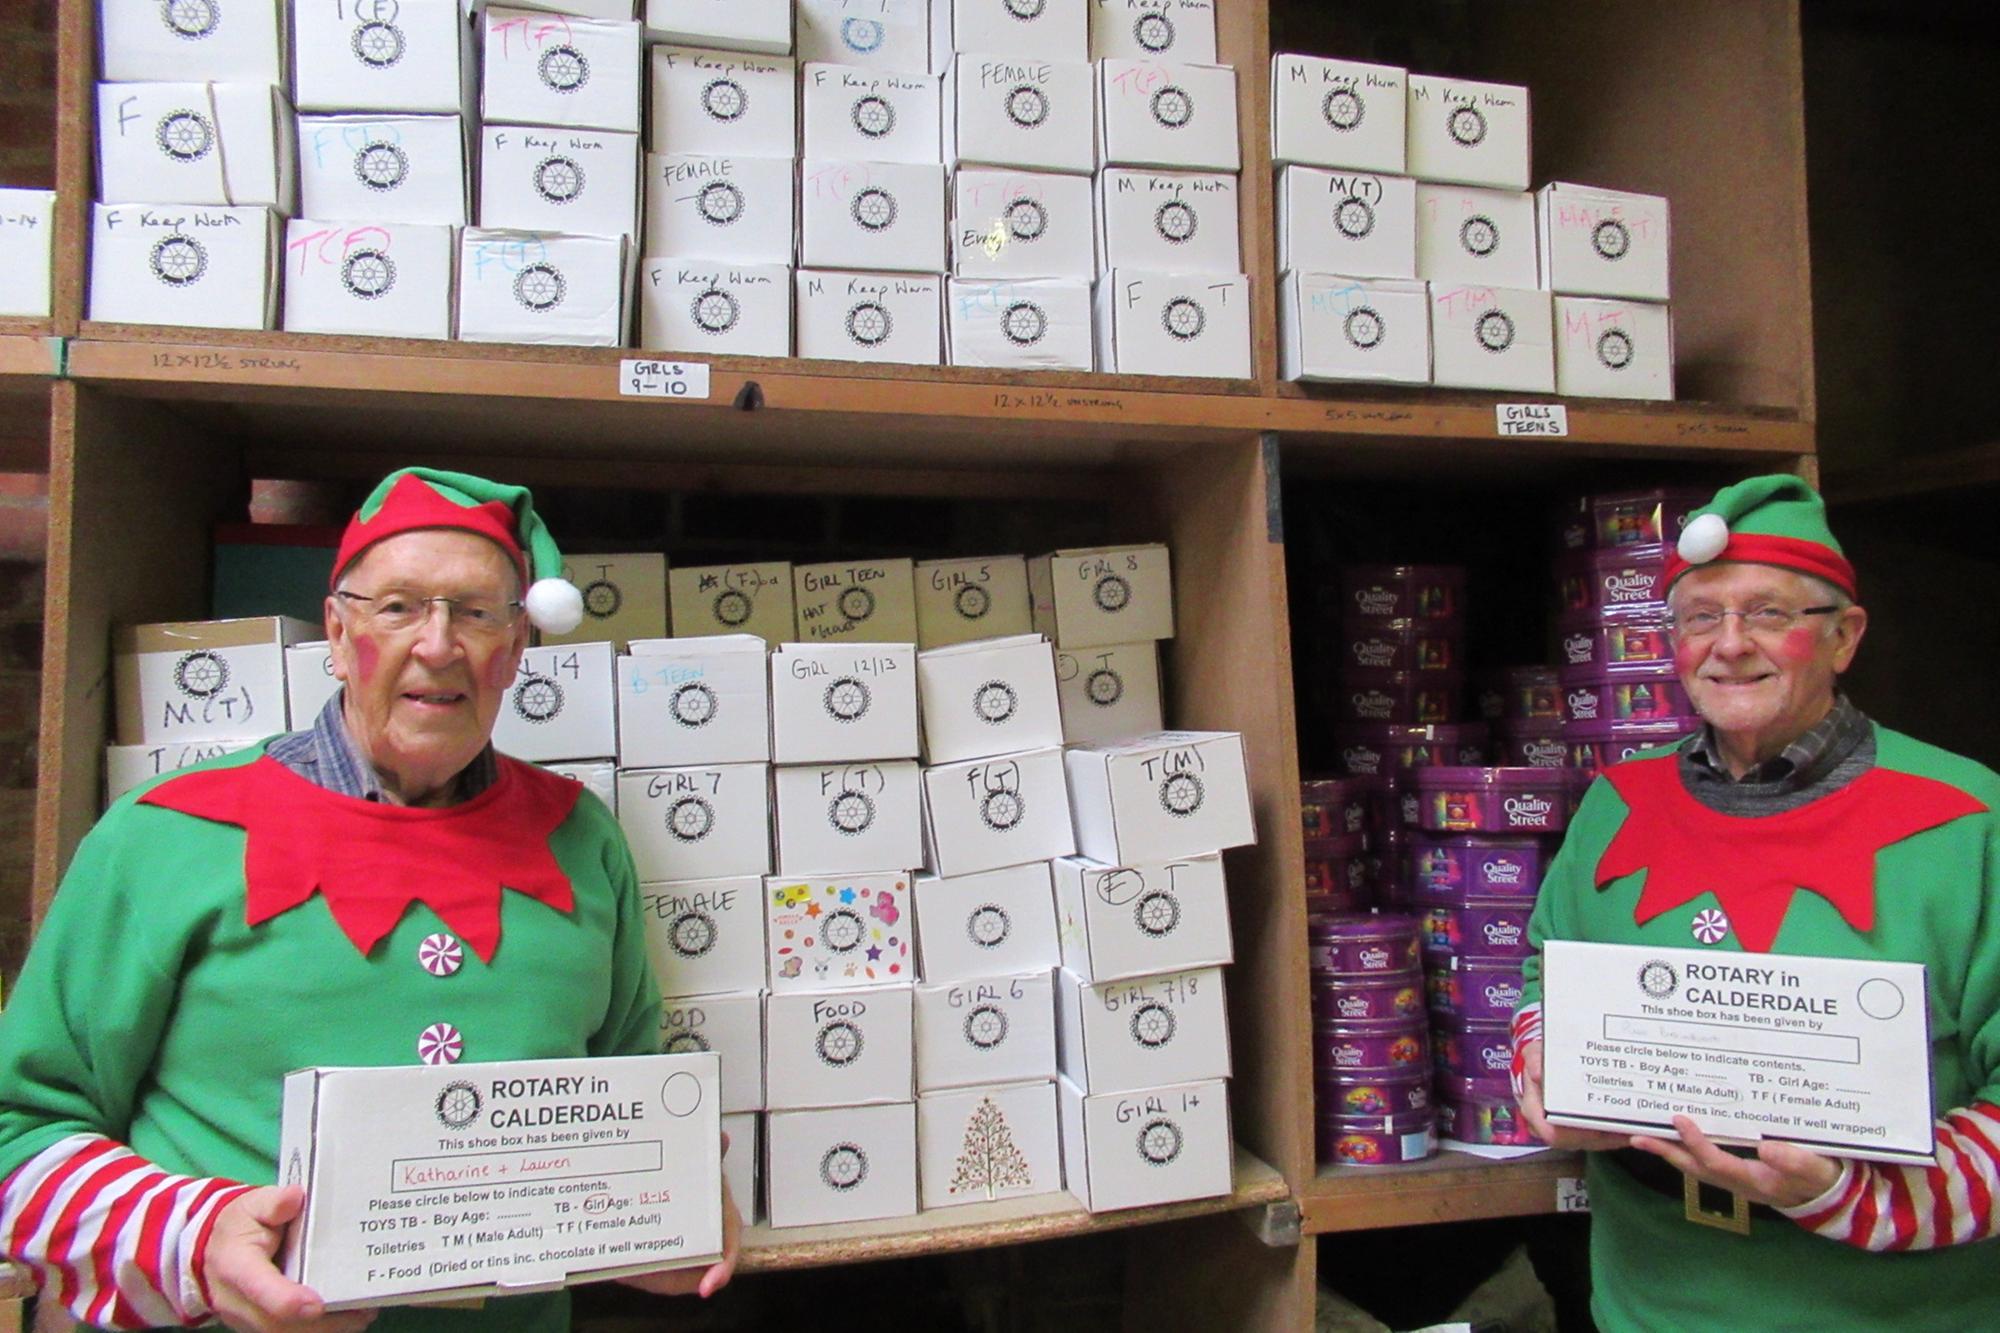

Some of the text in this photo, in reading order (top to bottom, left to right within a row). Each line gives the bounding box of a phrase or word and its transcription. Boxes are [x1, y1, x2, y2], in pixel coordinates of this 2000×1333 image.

[694, 56, 734, 75] Keep
[981, 63, 1052, 88] FEMALE
[815, 71, 826, 87] F
[843, 75, 878, 91] Keep
[1291, 66, 1307, 84] M
[1323, 67, 1359, 89] Keep
[1415, 87, 1477, 108] M Keep
[118, 95, 141, 136] F
[495, 134, 507, 149] F
[663, 159, 733, 186] FEMALE
[1119, 179, 1135, 192] M
[1150, 178, 1184, 197] Keep
[107, 210, 120, 229] F
[141, 212, 187, 233] Keep
[651, 270, 663, 286] F
[678, 271, 719, 291] Keep
[809, 283, 824, 296] M
[848, 279, 886, 300] Keep
[1127, 281, 1234, 309] F T
[1506, 406, 1552, 421] GIRLS
[1502, 420, 1561, 435] TEENS
[932, 565, 990, 591] GIRL 5
[1079, 555, 1138, 580] GIRL 8
[804, 568, 885, 592] GIRL TEEN
[1605, 572, 1656, 591] Quality
[1611, 587, 1652, 602] Street
[553, 652, 580, 679] 14
[792, 658, 896, 679] GIRL 12/13
[1568, 693, 1598, 708] Quality
[648, 773, 721, 798] GIRL 7
[1504, 798, 1552, 816] Quality
[1509, 812, 1548, 826] Street
[1483, 862, 1522, 877] Quality
[1487, 873, 1519, 884] Street
[1483, 924, 1522, 939] Quality
[1488, 934, 1519, 946] Street
[1686, 964, 1800, 987] ROTARY in
[948, 980, 1024, 1007] GIRL 6
[1104, 986, 1154, 1011] GIRL
[1337, 998, 1370, 1011] Quality
[1686, 987, 1838, 1015] CALDERDALE
[814, 1001, 867, 1022] FOOD
[1641, 1004, 1823, 1031] This shoe box has been given by
[1332, 1046, 1363, 1059] Quality
[1586, 1041, 1806, 1071] Please circle below to indicate contents.
[1580, 1055, 1830, 1091] TOYS TB Boy Age: TB Girl Age:
[491, 1076, 609, 1099] ROTARY in
[1586, 1073, 1634, 1087] Toiletries
[1676, 1084, 1702, 1095] Male
[1780, 1094, 1821, 1106] Female
[1824, 1098, 1861, 1113] Adult)
[490, 1102, 644, 1128] CALDERDALE
[1116, 1097, 1167, 1122] GIRL
[1604, 1094, 1886, 1137] Food (Dried or tins inc. chocolate if well wrapped)
[439, 1127, 630, 1150] This shoe box has been given by
[405, 1156, 571, 1185] Katharine Lauren
[368, 1181, 611, 1211] Please circle below to indicate contents.
[360, 1218, 396, 1233] TOYS
[400, 1216, 418, 1229] TB
[433, 1213, 458, 1227] Boy
[461, 1211, 490, 1224] Age:
[554, 1202, 570, 1213] TB
[584, 1199, 605, 1211] Girl
[607, 1198, 633, 1211] Age:
[366, 1213, 661, 1257] Toiletries Male Adult) Female Adult)
[388, 1235, 684, 1279] Food (Dried or tins inc. chocolate if well wrapped)
